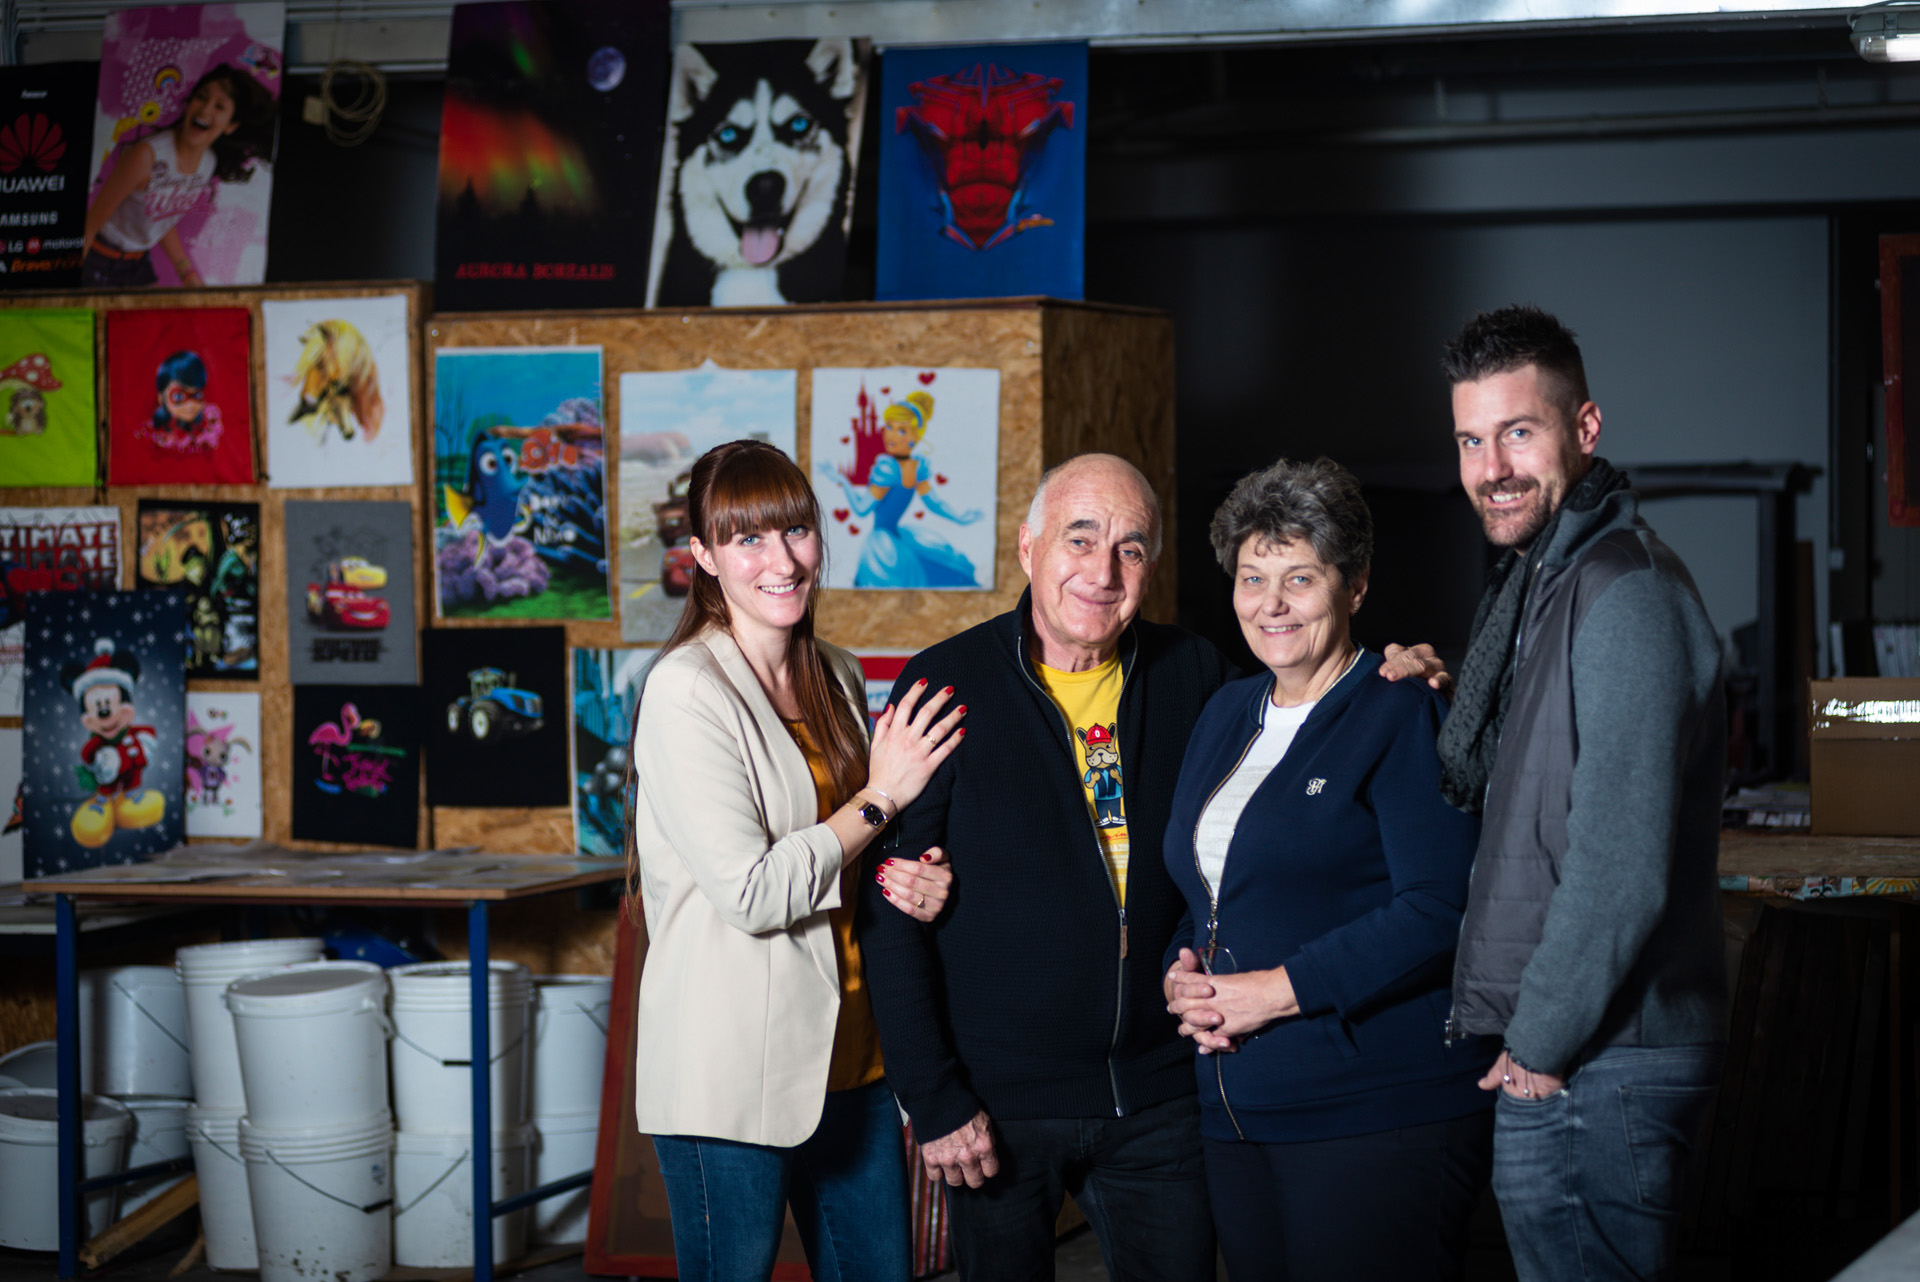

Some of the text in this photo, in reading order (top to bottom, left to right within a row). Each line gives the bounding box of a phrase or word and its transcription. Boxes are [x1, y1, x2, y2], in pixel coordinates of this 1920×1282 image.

[0, 211, 58, 227] AMSUNG
[455, 262, 614, 280] AURORA BOREALIS
